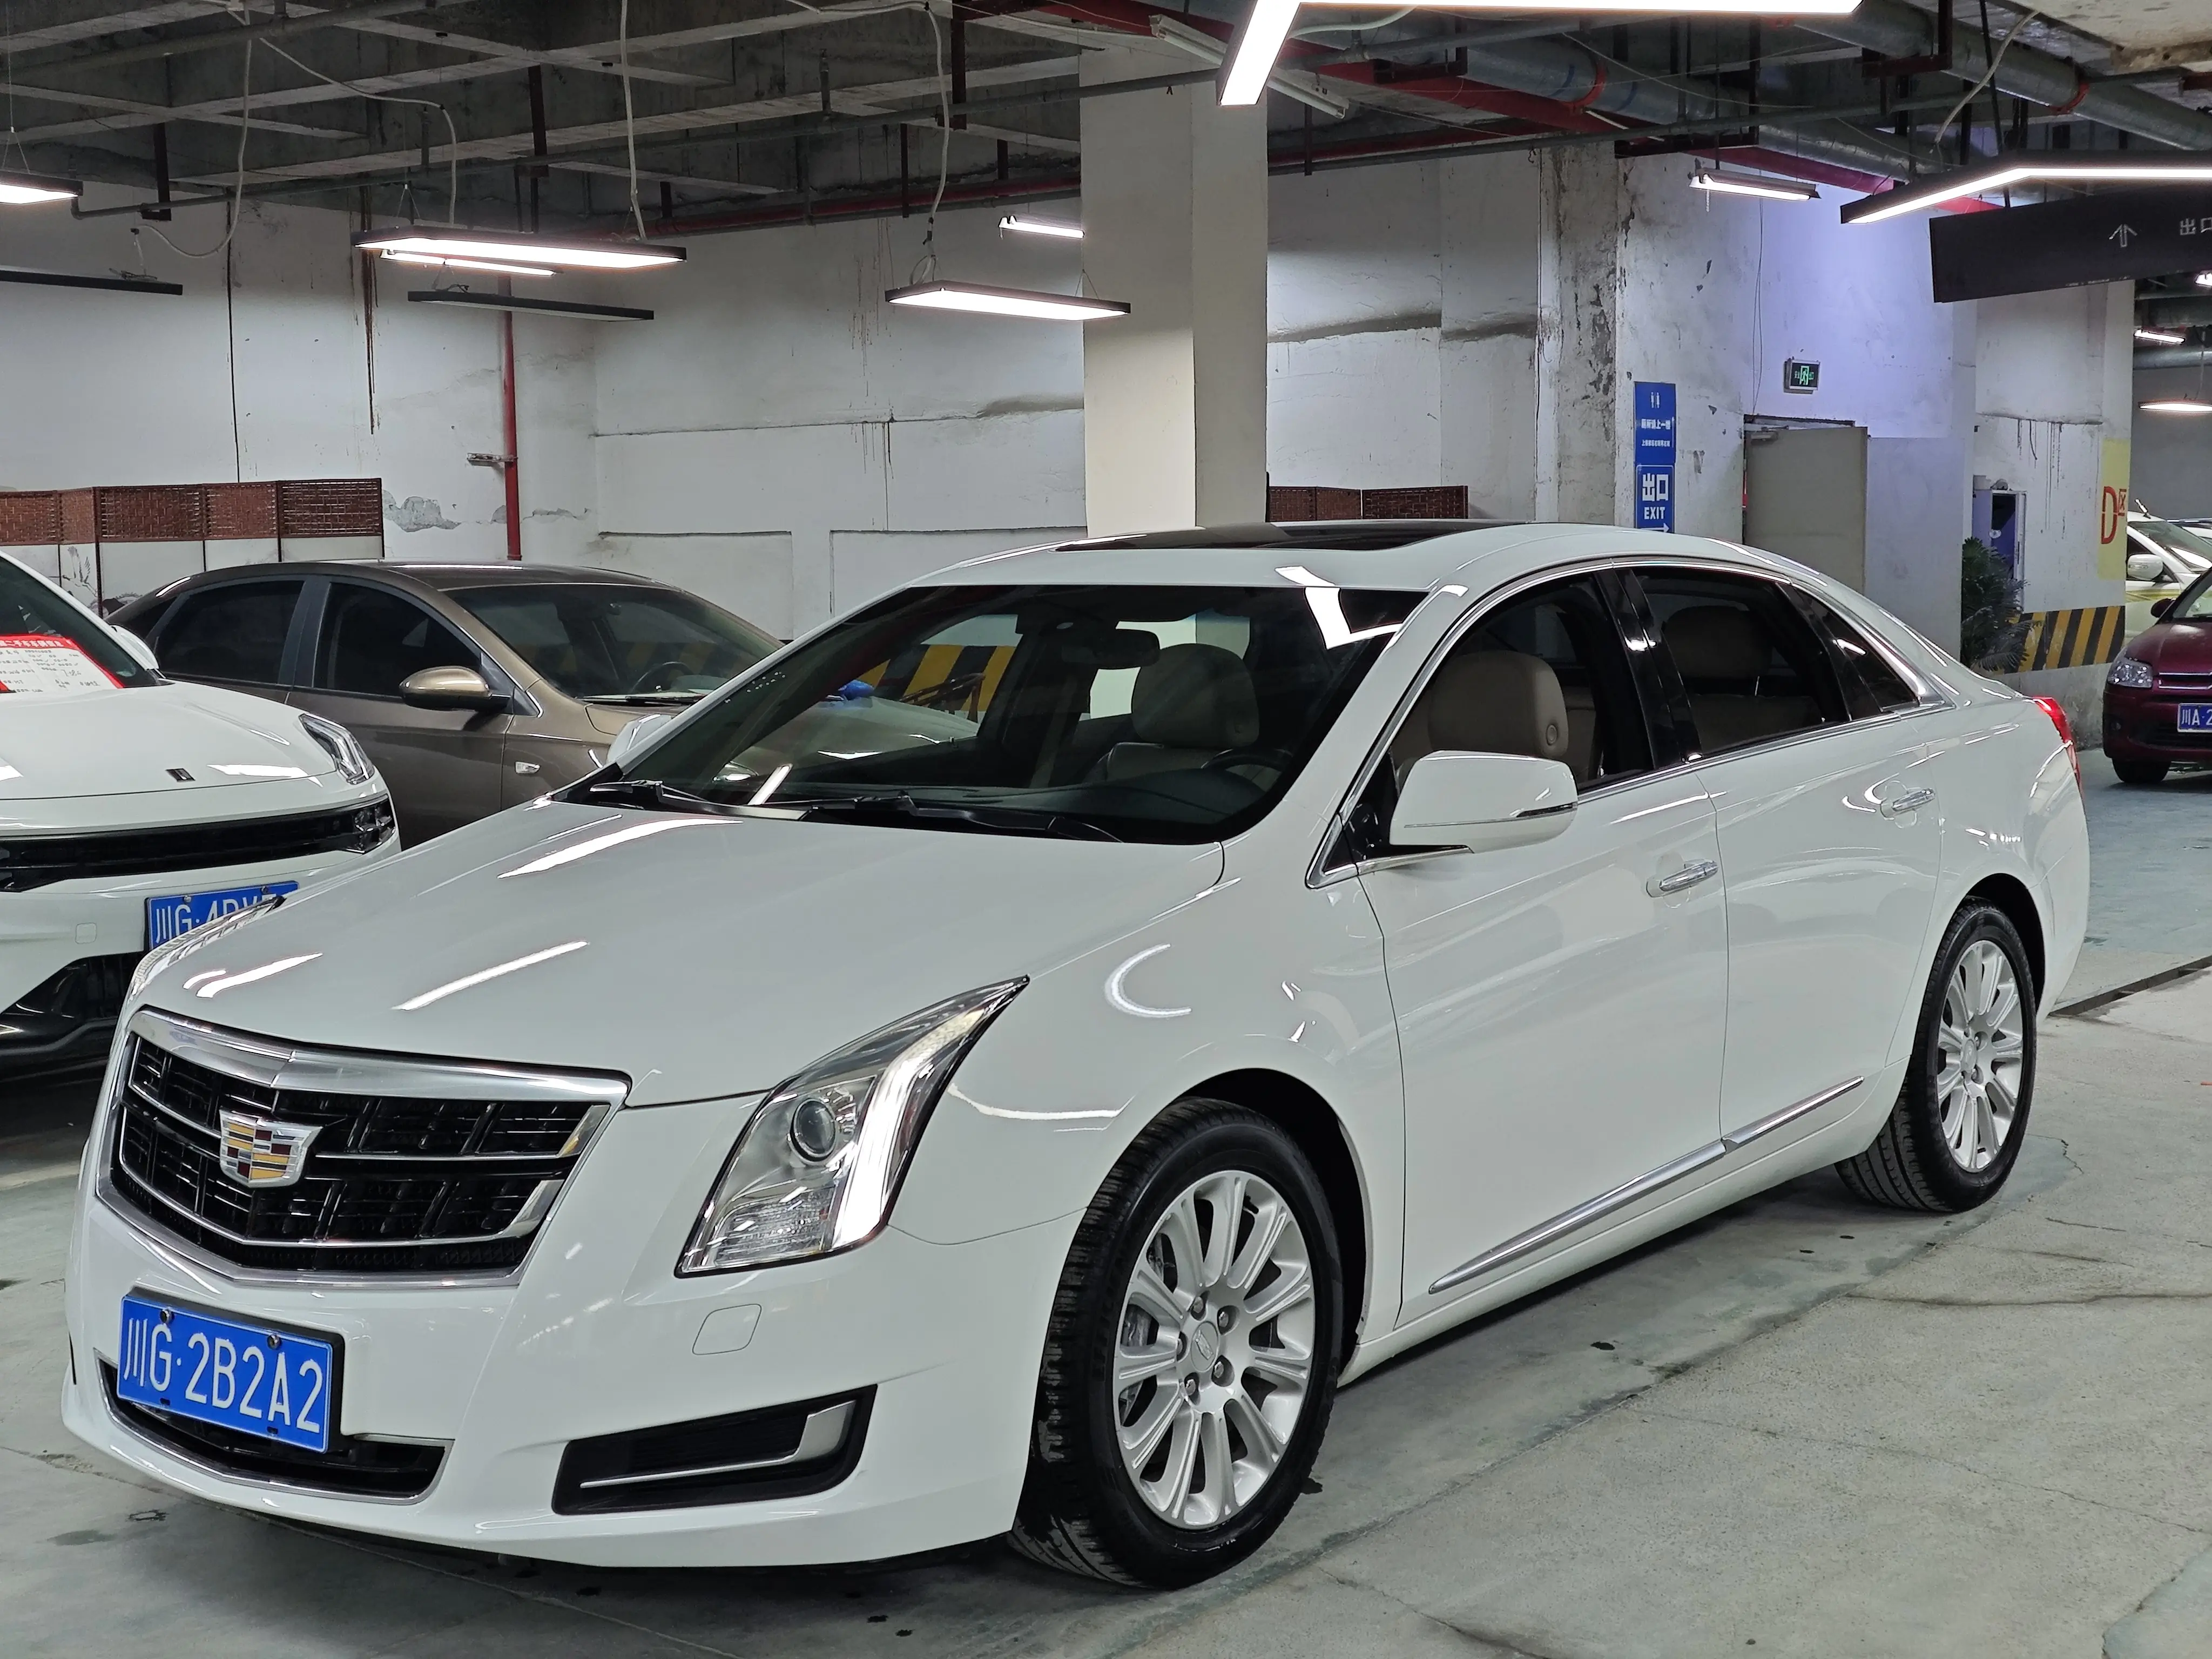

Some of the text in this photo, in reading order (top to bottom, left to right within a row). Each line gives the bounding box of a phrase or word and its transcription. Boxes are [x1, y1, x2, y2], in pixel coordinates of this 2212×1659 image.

[2180, 217, 2212, 235] 出口
[1642, 473, 1669, 502] 出口
[1644, 507, 1665, 520] EXIT
[123, 1318, 323, 1434] 川G·2B2A2
